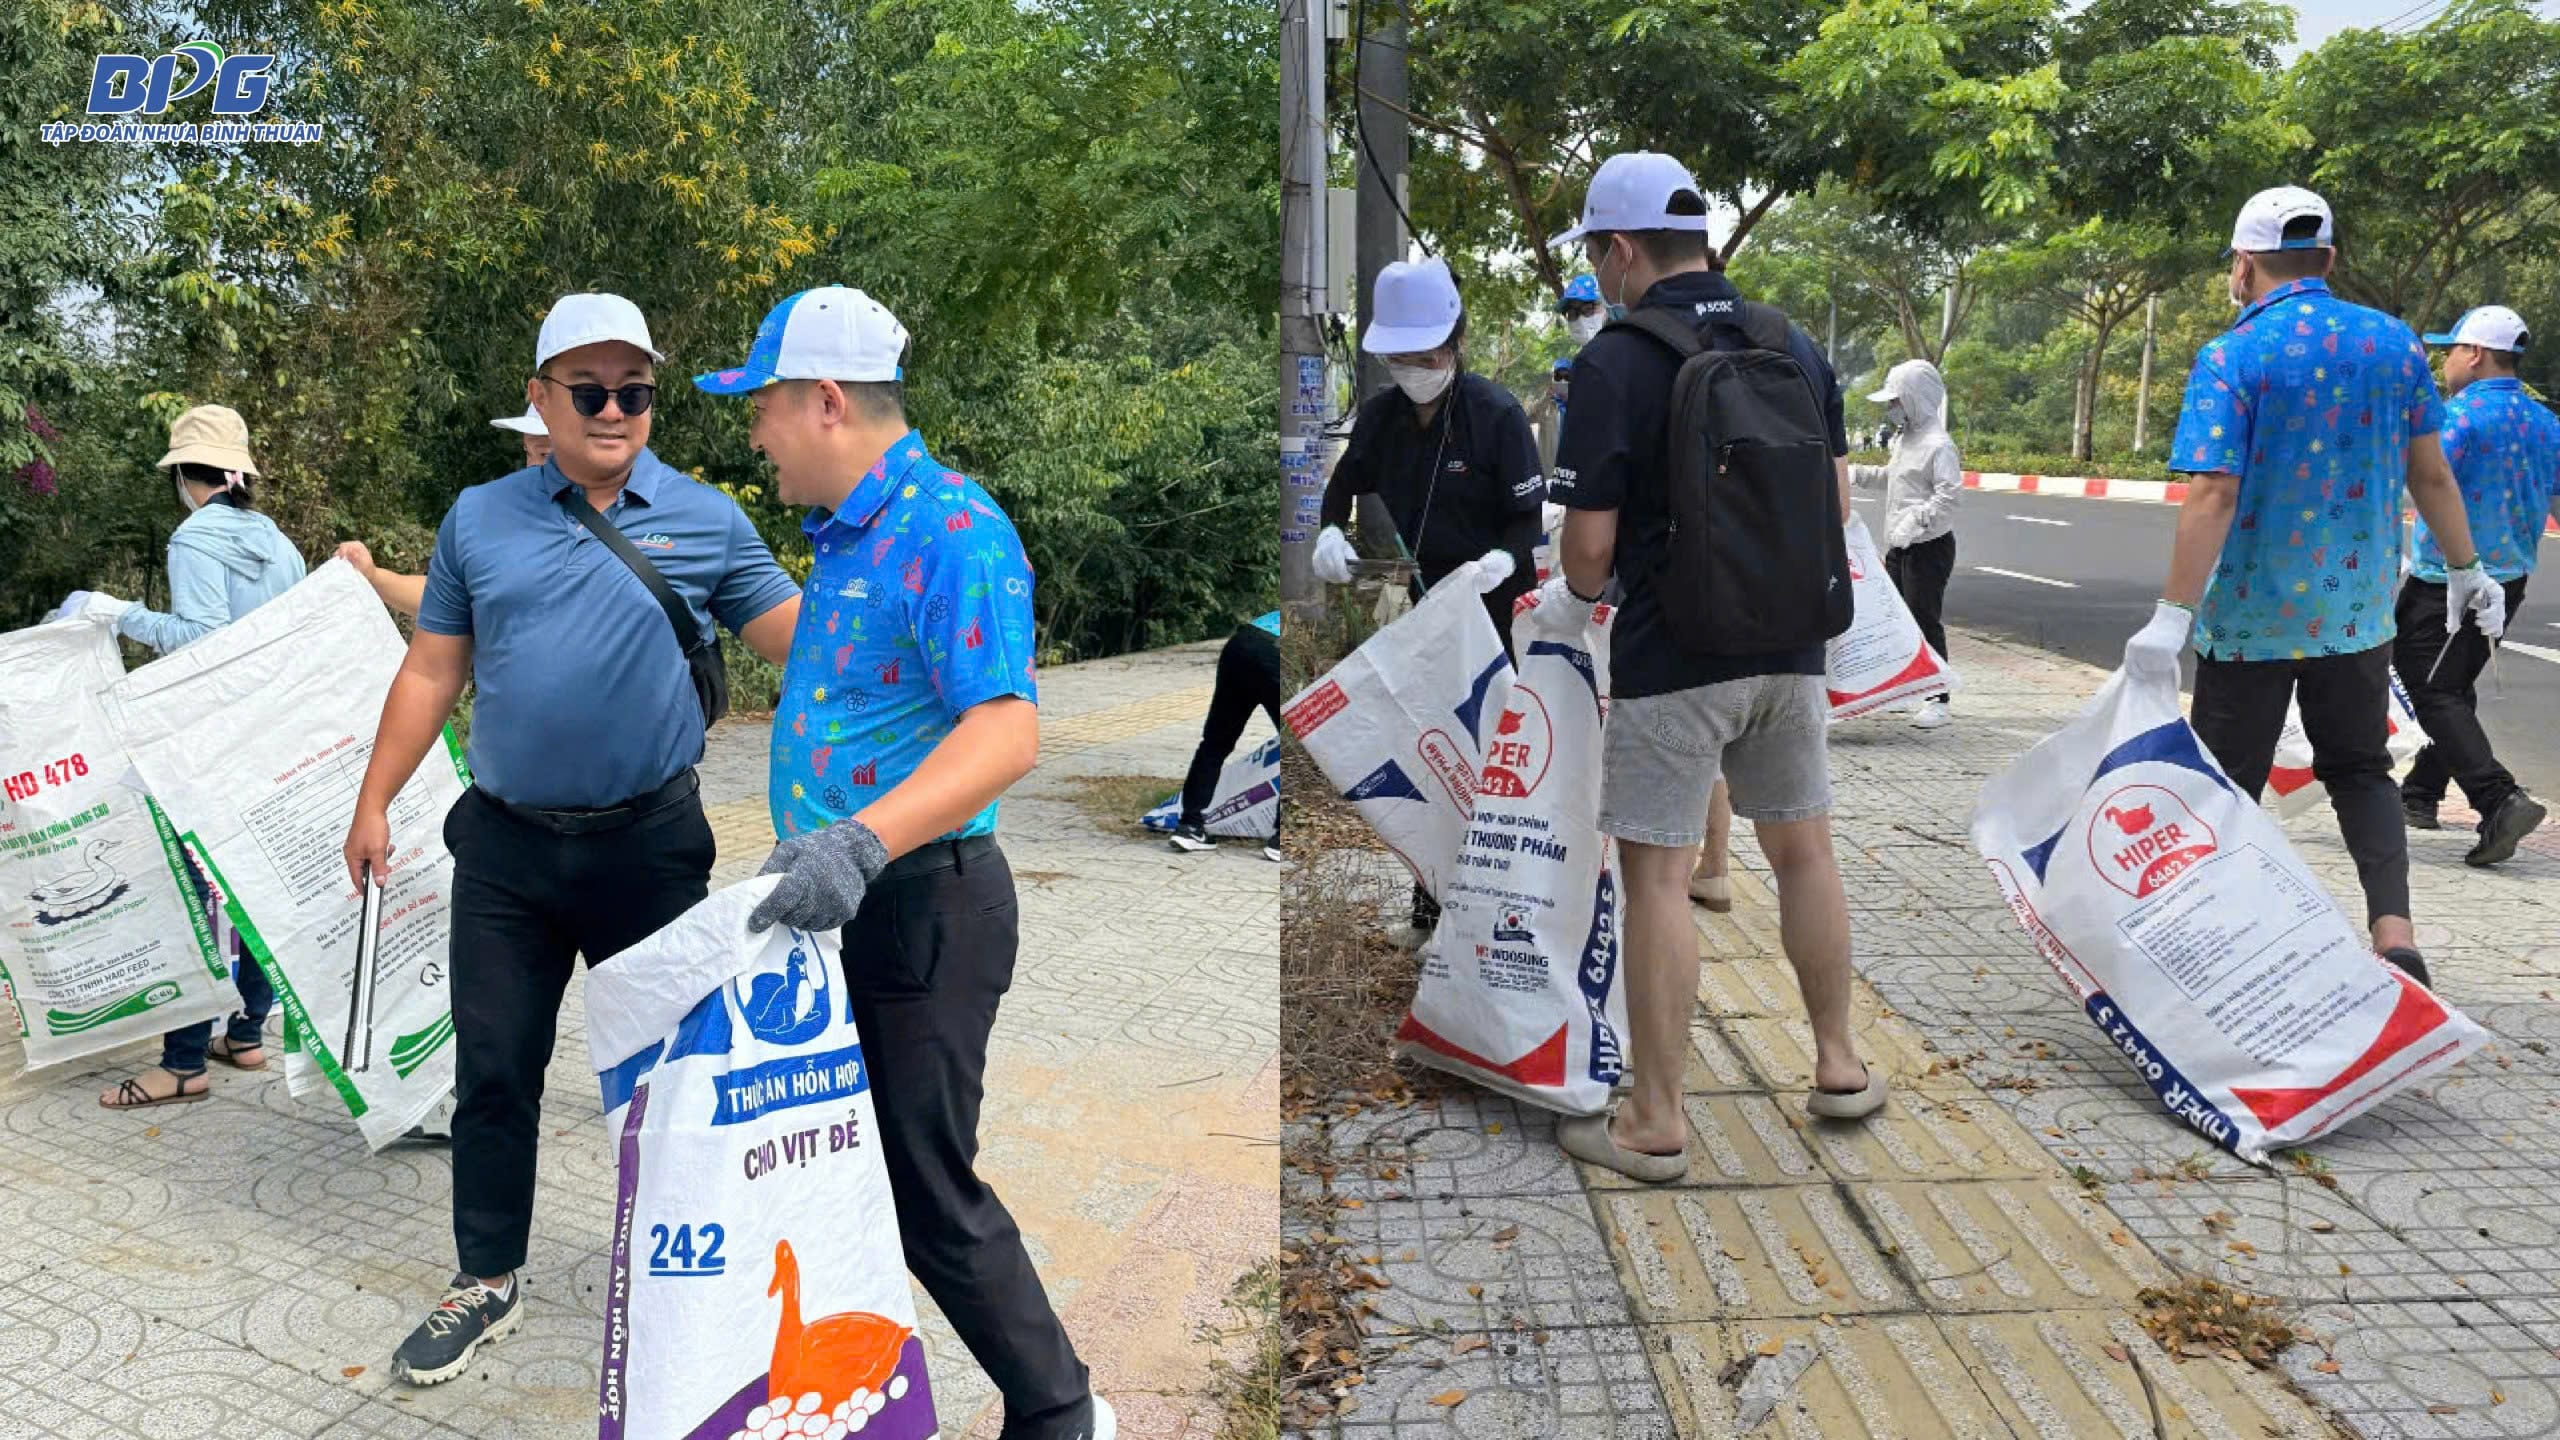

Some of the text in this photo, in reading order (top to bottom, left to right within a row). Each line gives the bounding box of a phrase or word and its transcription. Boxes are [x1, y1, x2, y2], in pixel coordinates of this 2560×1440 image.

[643, 532, 670, 544] LSP
[3, 753, 89, 802] HD 478
[1486, 740, 1531, 768] PER
[2113, 823, 2190, 872] HIPER
[63, 982, 75, 995] TY
[77, 978, 103, 991] TNHH
[127, 959, 149, 973] FEED
[728, 1059, 860, 1113] THỨC ĂN HỖN HỢP
[2097, 1006, 2229, 1142] HIPER 6442 S
[744, 1108, 860, 1180] CHO VỊT ĐẺ
[650, 1223, 726, 1269] 242
[615, 1266, 627, 1298] ĂN
[610, 1307, 628, 1360] HỖN
[607, 1368, 621, 1422] HỢP
